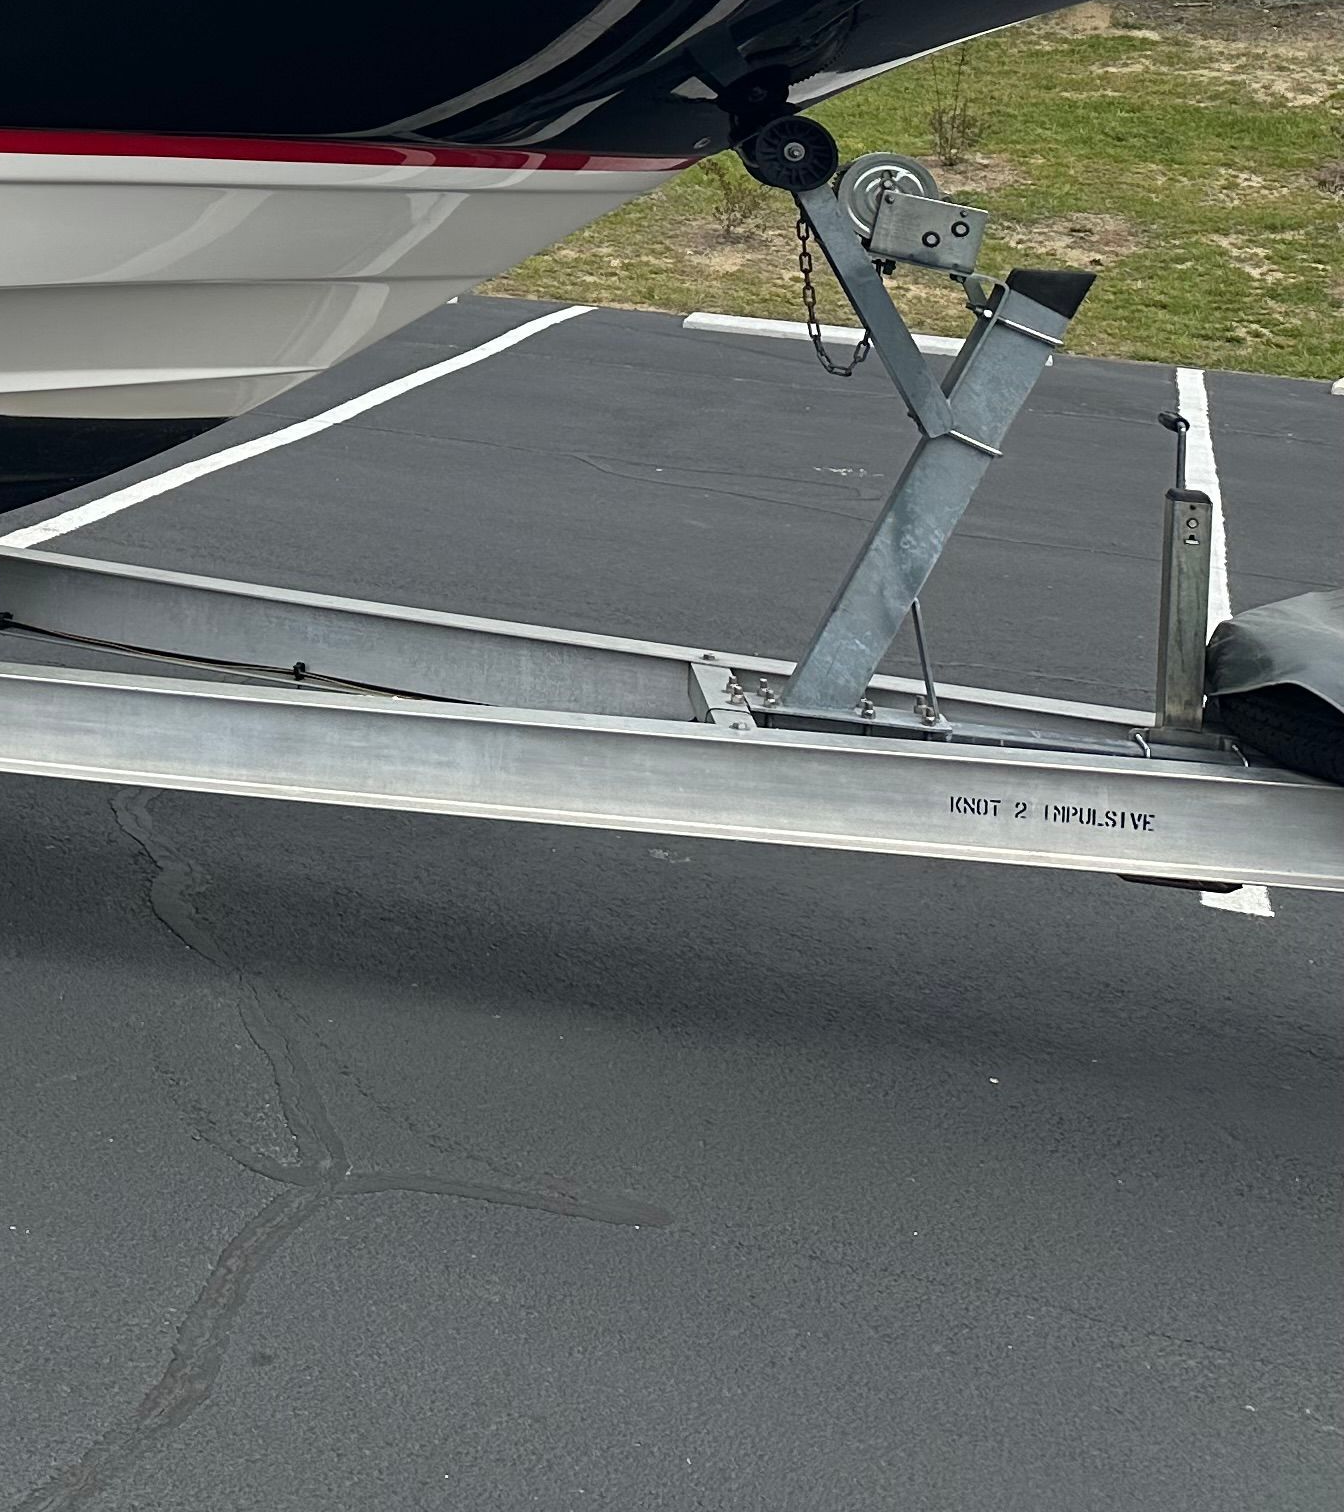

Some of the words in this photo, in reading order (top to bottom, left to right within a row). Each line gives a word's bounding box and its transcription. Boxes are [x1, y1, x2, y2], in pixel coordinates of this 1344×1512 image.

[949, 795, 1002, 817] KNOT
[1014, 801, 1028, 819] 2
[1044, 804, 1156, 832] IMPULSIVE
